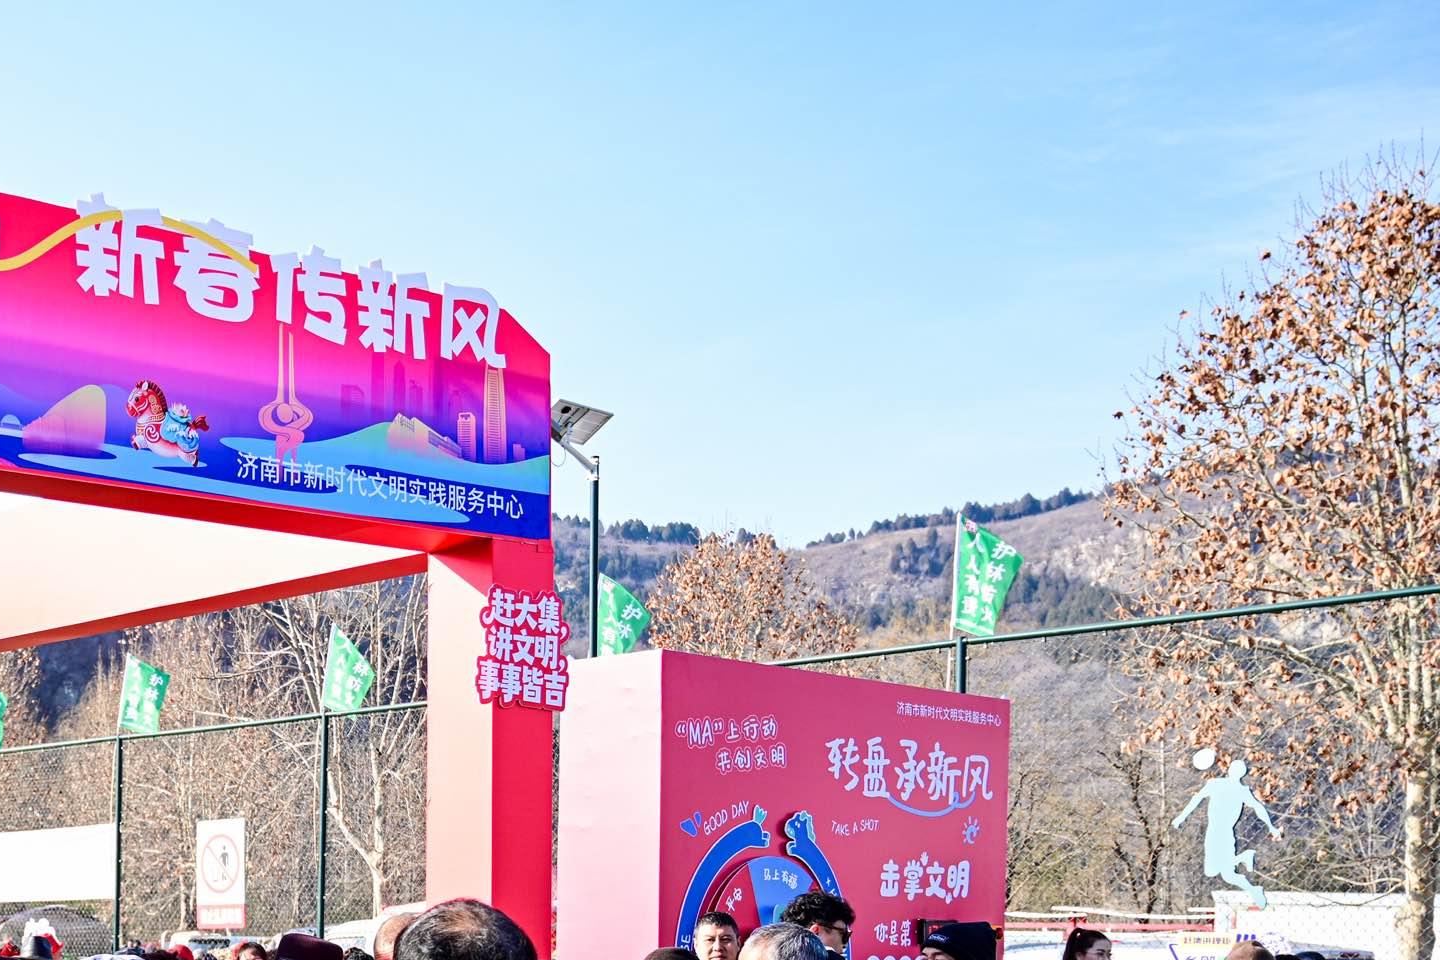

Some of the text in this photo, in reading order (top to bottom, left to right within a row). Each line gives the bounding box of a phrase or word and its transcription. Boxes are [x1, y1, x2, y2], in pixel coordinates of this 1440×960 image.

[76, 192, 506, 368] 新春传新风
[237, 451, 524, 520] 济南市新时代文明实践服务中心
[477, 659, 567, 708] 事事皆吉
[896, 701, 1002, 728] 济南市新时代文明实践服务中心
[715, 745, 787, 775] 共创文明
[825, 737, 993, 803] 转盘承新风
[702, 800, 750, 836] GOOD DAY
[831, 818, 879, 836] TAKE A SHOT
[880, 857, 971, 902] 击掌文明
[873, 919, 912, 947] 你是第
